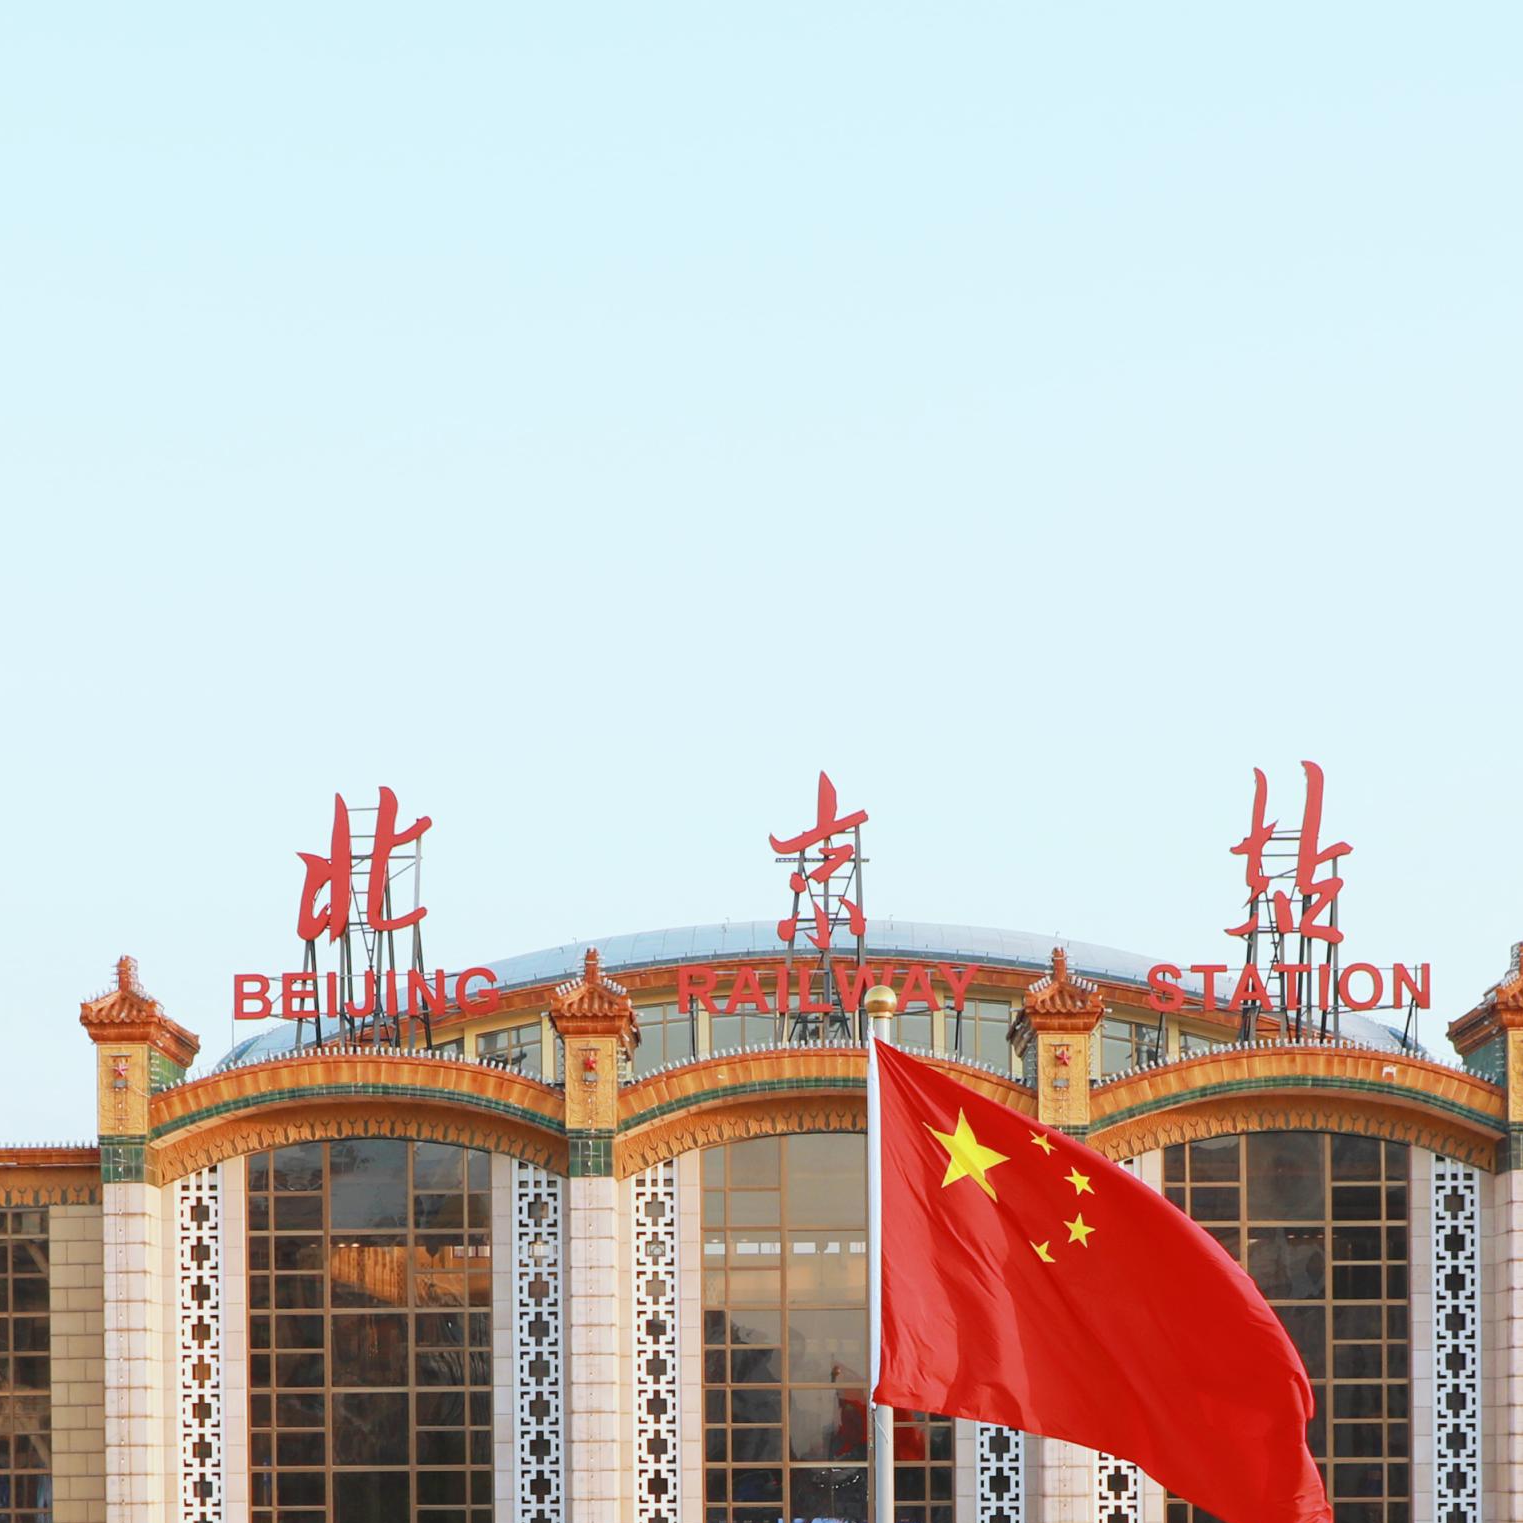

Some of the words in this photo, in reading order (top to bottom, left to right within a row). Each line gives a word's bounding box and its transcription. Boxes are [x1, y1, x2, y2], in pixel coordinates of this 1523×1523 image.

[297, 763, 1352, 949] 北京站
[234, 966, 501, 1020] BEIJING
[676, 961, 980, 1014] RAILWAY
[1147, 963, 1431, 1016] STATION
